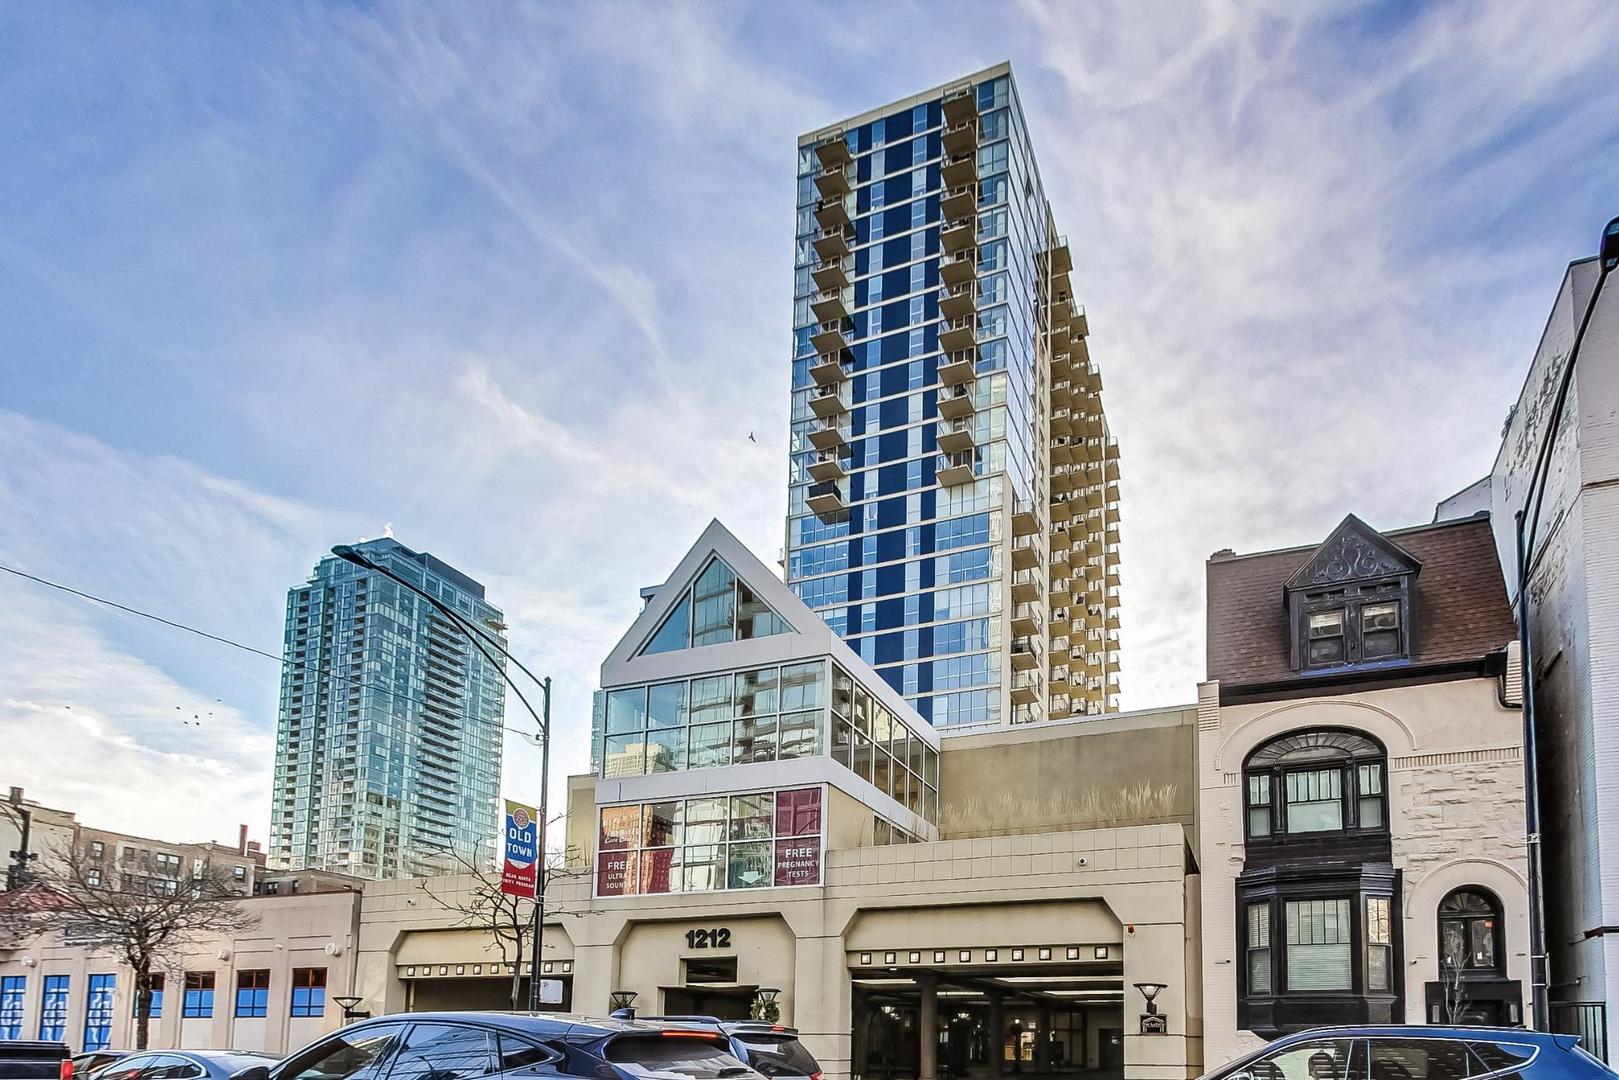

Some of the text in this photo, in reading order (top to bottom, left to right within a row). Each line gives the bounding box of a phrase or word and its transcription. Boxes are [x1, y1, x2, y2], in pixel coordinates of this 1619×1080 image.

[509, 827, 532, 843] OLD
[507, 842, 532, 857] TOWN
[785, 847, 813, 858] FREE
[607, 861, 632, 870] FREE
[777, 860, 820, 869] PREGNANCY
[788, 870, 809, 878] TESTS
[685, 927, 731, 949] 1212
